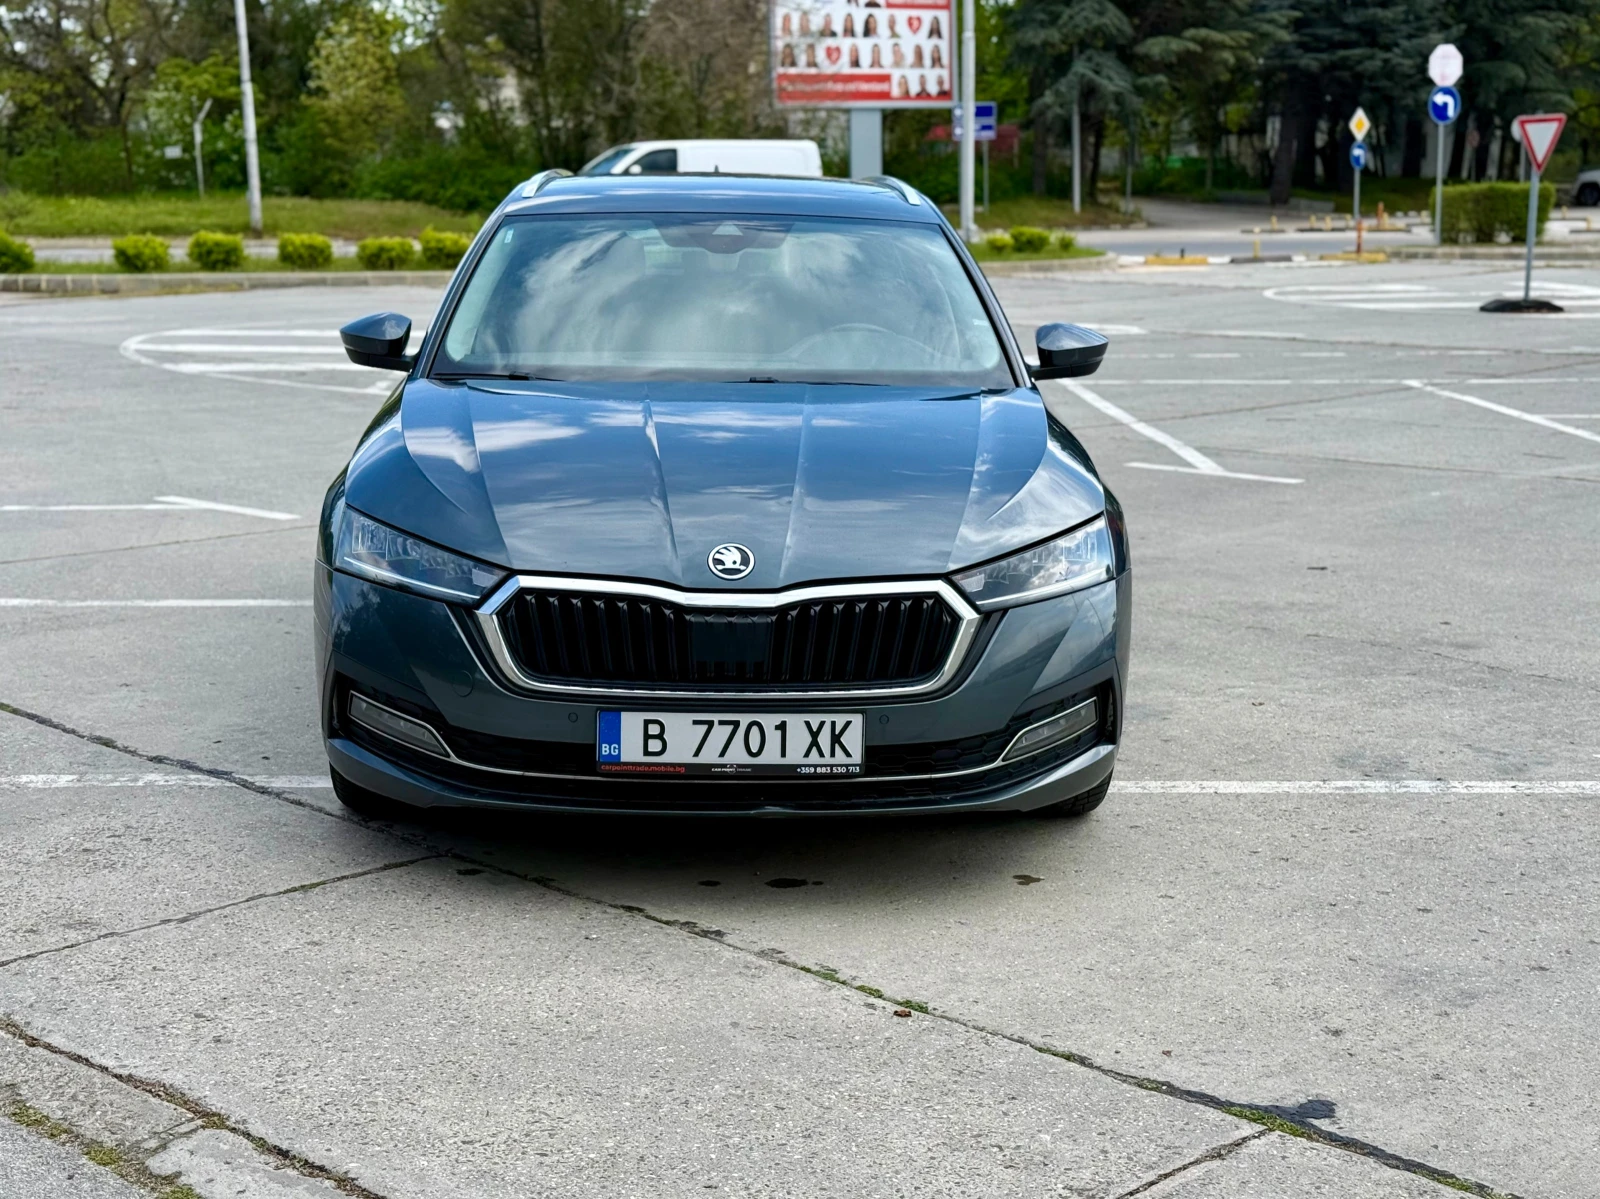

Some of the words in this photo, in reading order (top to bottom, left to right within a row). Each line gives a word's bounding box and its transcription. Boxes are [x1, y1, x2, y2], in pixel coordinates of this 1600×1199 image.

[642, 718, 668, 757] B
[692, 719, 787, 758] 7701
[802, 720, 853, 758] XK
[601, 743, 619, 756] BG
[601, 764, 686, 773] carpointtrade.mobile.bg
[797, 766, 815, 774] +359
[816, 766, 831, 774] 883
